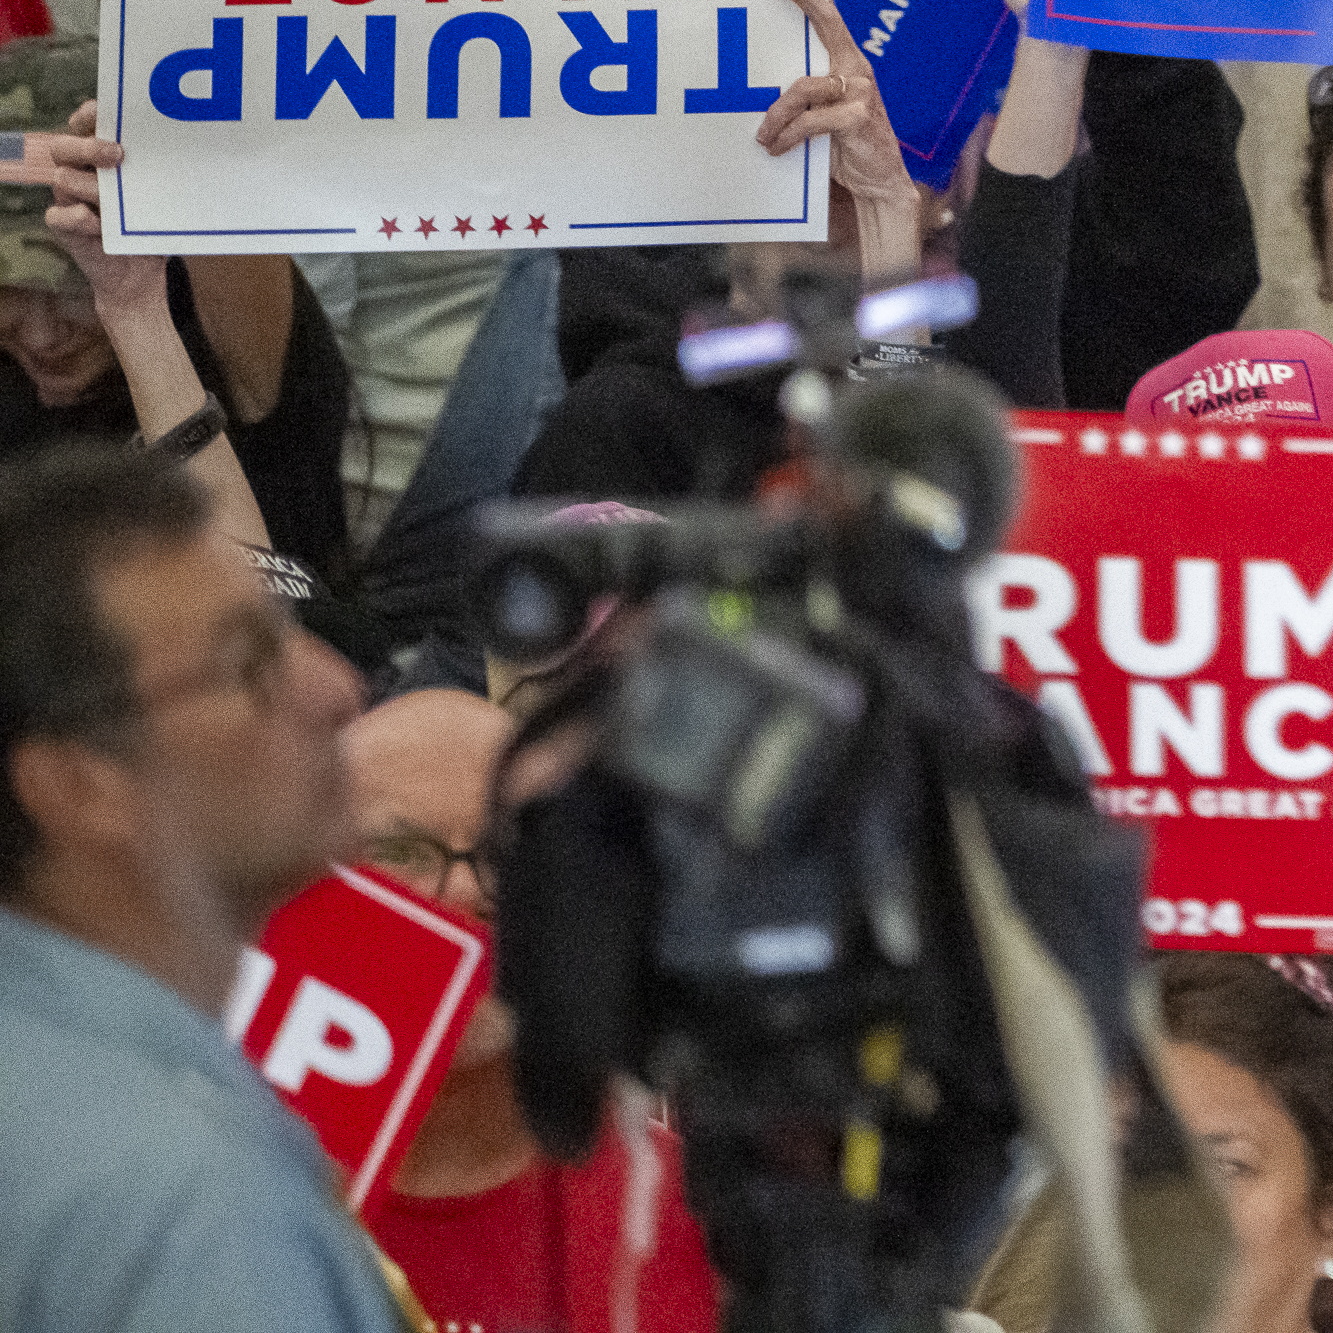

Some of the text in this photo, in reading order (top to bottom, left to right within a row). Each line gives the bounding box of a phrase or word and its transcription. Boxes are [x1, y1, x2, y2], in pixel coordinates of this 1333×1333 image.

[148, 6, 782, 122] TRUMP
[1162, 363, 1295, 414] TRUMP
[1188, 386, 1268, 417] VANCE
[1232, 400, 1274, 415] GREAT
[1191, 790, 1324, 820] GREAT
[1141, 898, 1245, 936] 024
